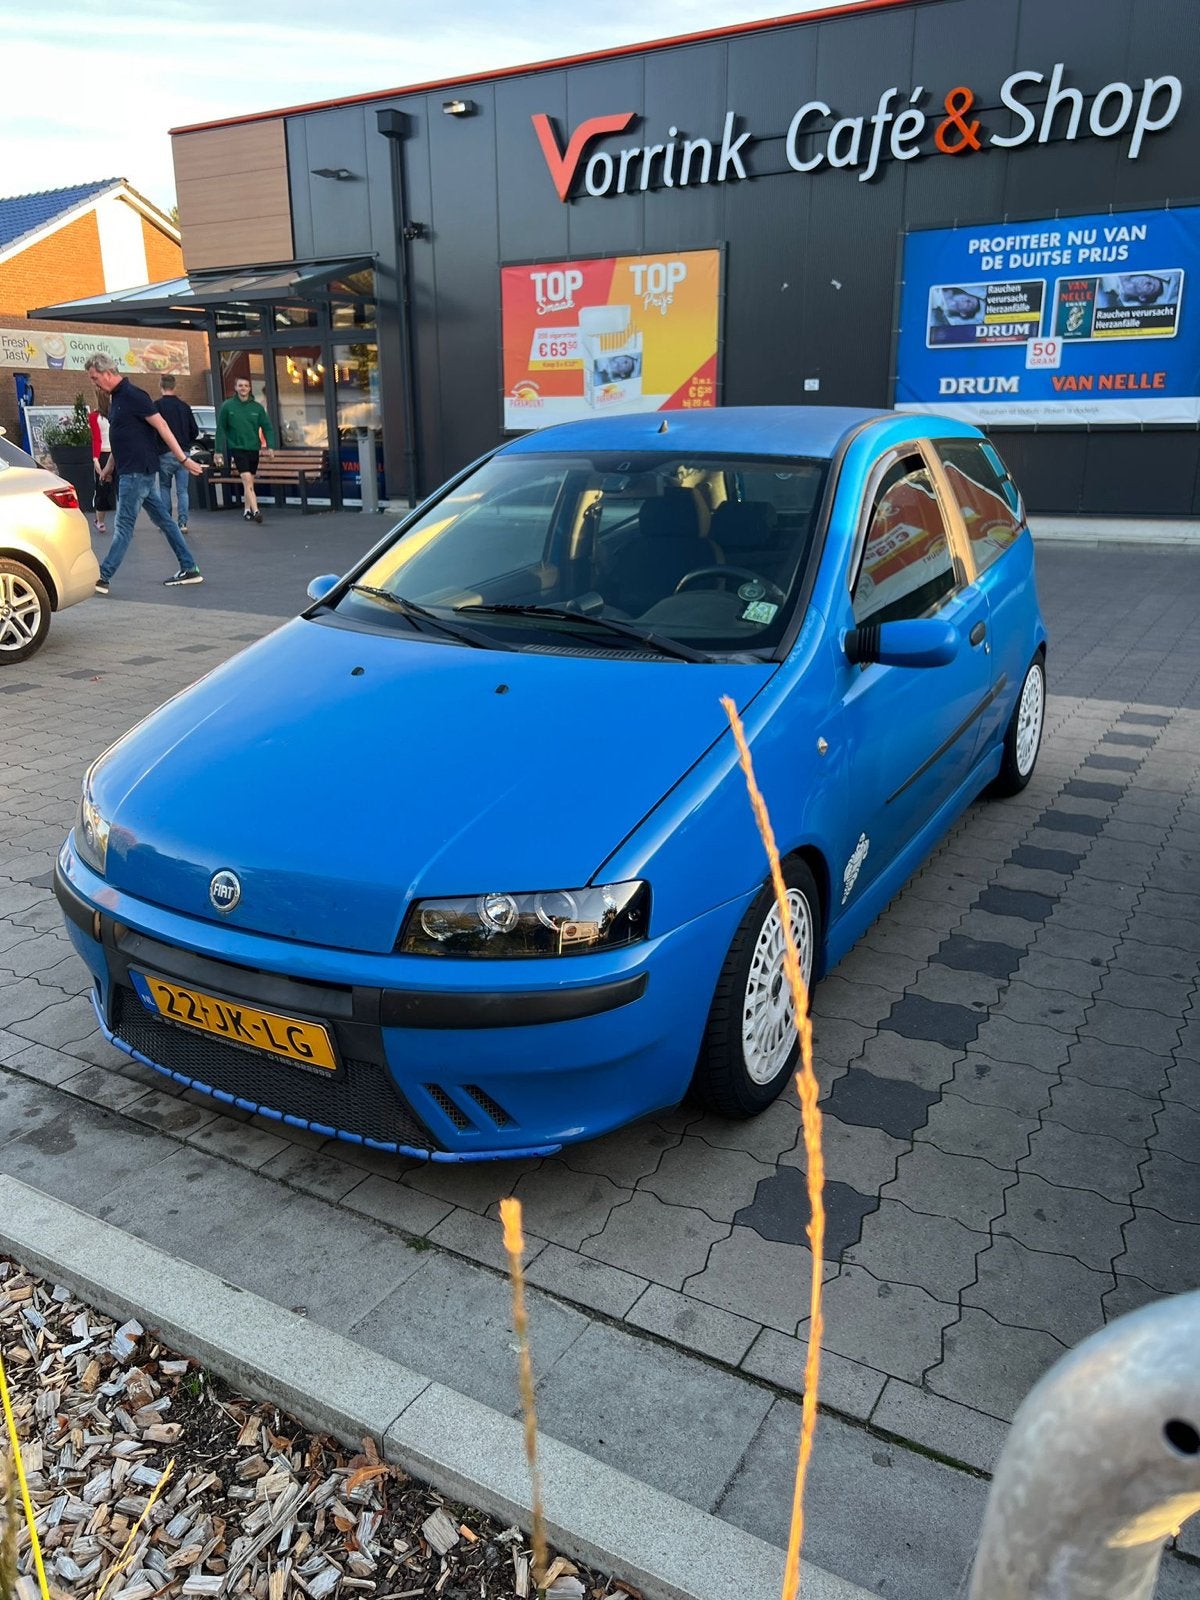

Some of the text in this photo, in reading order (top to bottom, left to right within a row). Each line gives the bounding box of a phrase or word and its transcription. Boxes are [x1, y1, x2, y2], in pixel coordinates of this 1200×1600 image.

[531, 63, 1183, 203] Vorrink Café & Shop
[968, 225, 1147, 254] PROFITEER NU VAN
[981, 245, 1129, 271] DE DUITSE PRIJS
[629, 262, 687, 295] TOP
[530, 270, 583, 302] TOP
[988, 284, 1021, 294] Rauchen
[1068, 281, 1089, 290] VAN
[987, 293, 1028, 304] verursacht
[986, 303, 1030, 314] Herzanfälle
[1096, 306, 1174, 319] Rauchen verursacht
[975, 323, 1030, 337] DRUM
[1095, 319, 1140, 329] Herzanfälle
[1, 335, 30, 348] Fresh
[69, 340, 95, 351] Gönn
[4, 349, 31, 362] Tasty
[1033, 342, 1056, 356] 50
[71, 355, 88, 364] wa
[938, 372, 1167, 395] DRUM VAN NELLE
[213, 883, 234, 900] FIAT
[141, 993, 156, 1006] NL
[157, 985, 315, 1059] 22-JK-LG
